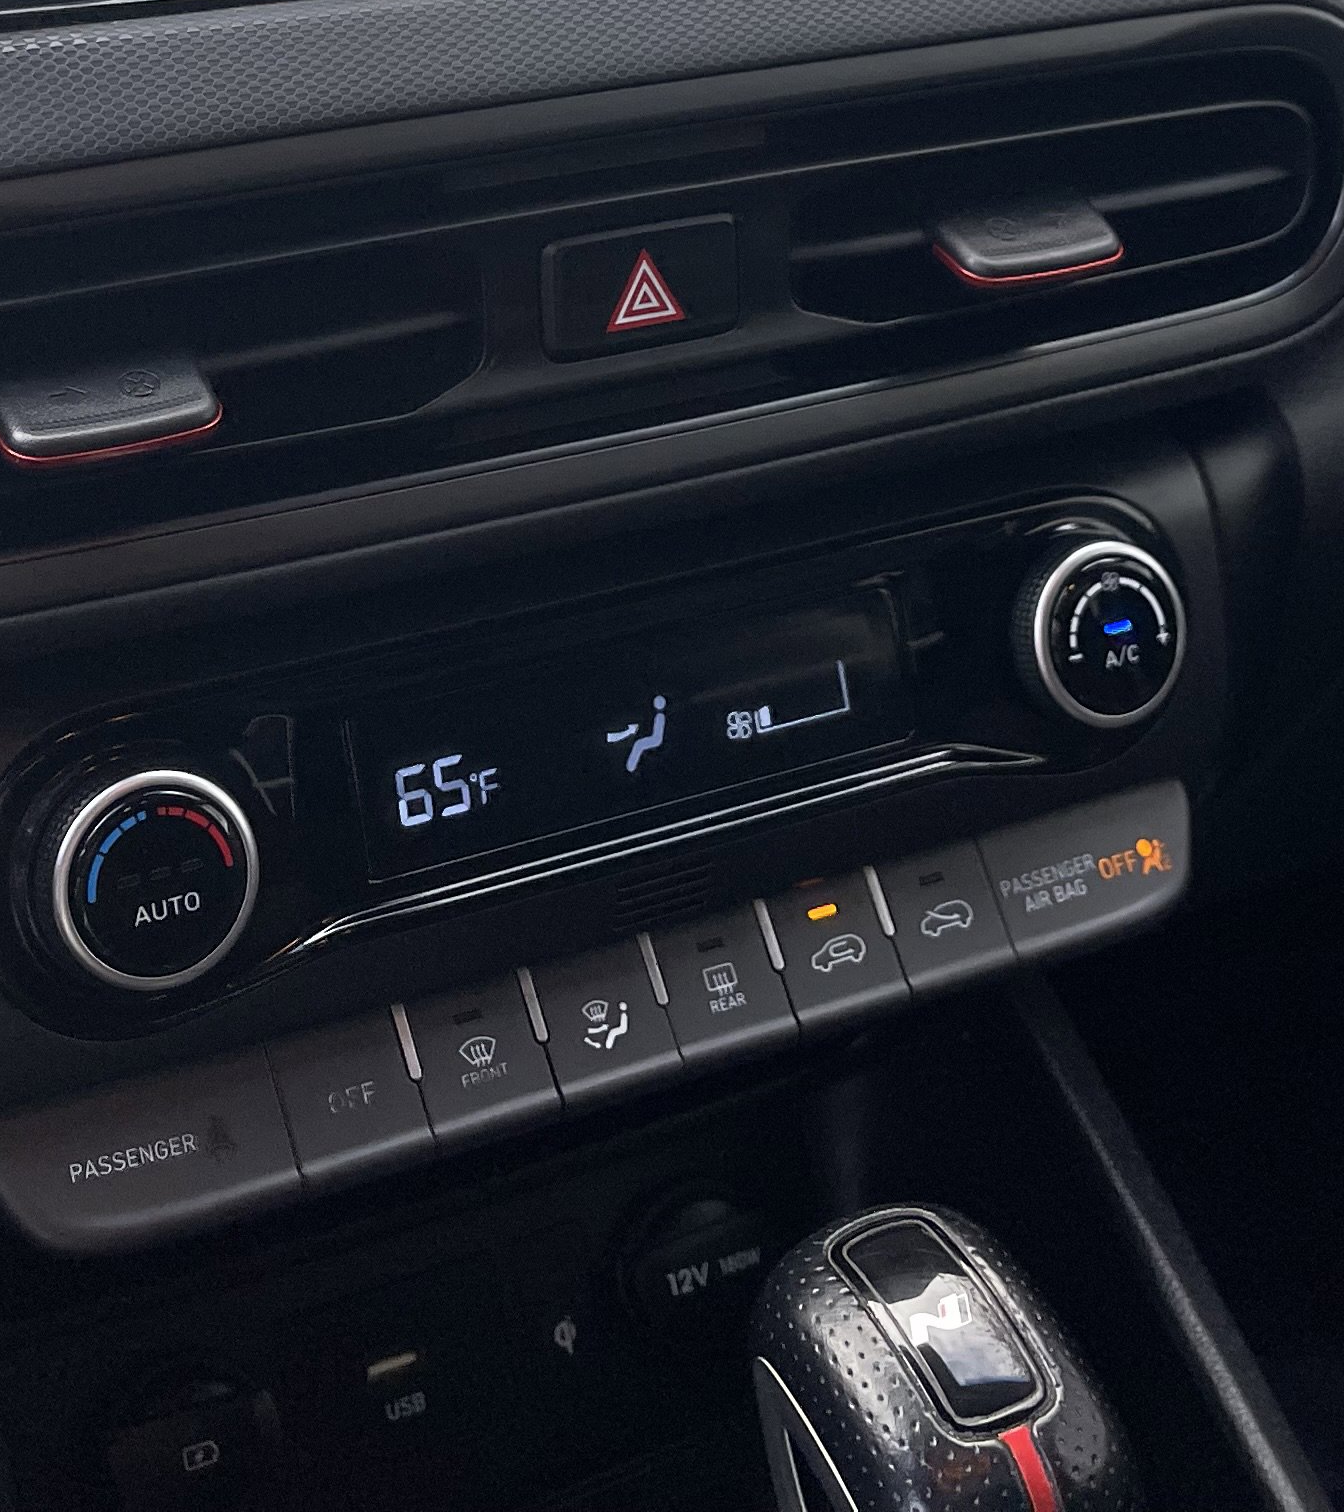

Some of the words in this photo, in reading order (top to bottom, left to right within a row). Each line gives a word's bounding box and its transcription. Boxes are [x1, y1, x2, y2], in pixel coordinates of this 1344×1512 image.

[1105, 644, 1141, 669] A/C
[999, 853, 1096, 897] PASSENGER
[1097, 850, 1137, 880] OFF
[135, 891, 200, 928] AUTO
[1025, 890, 1053, 913] AIR
[1054, 878, 1088, 903] BAG
[709, 992, 747, 1013] REAR
[461, 1062, 508, 1088] FRONT
[69, 1133, 197, 1184] PASSENGER
[666, 1262, 709, 1296] 12V
[385, 1391, 427, 1421] USB
